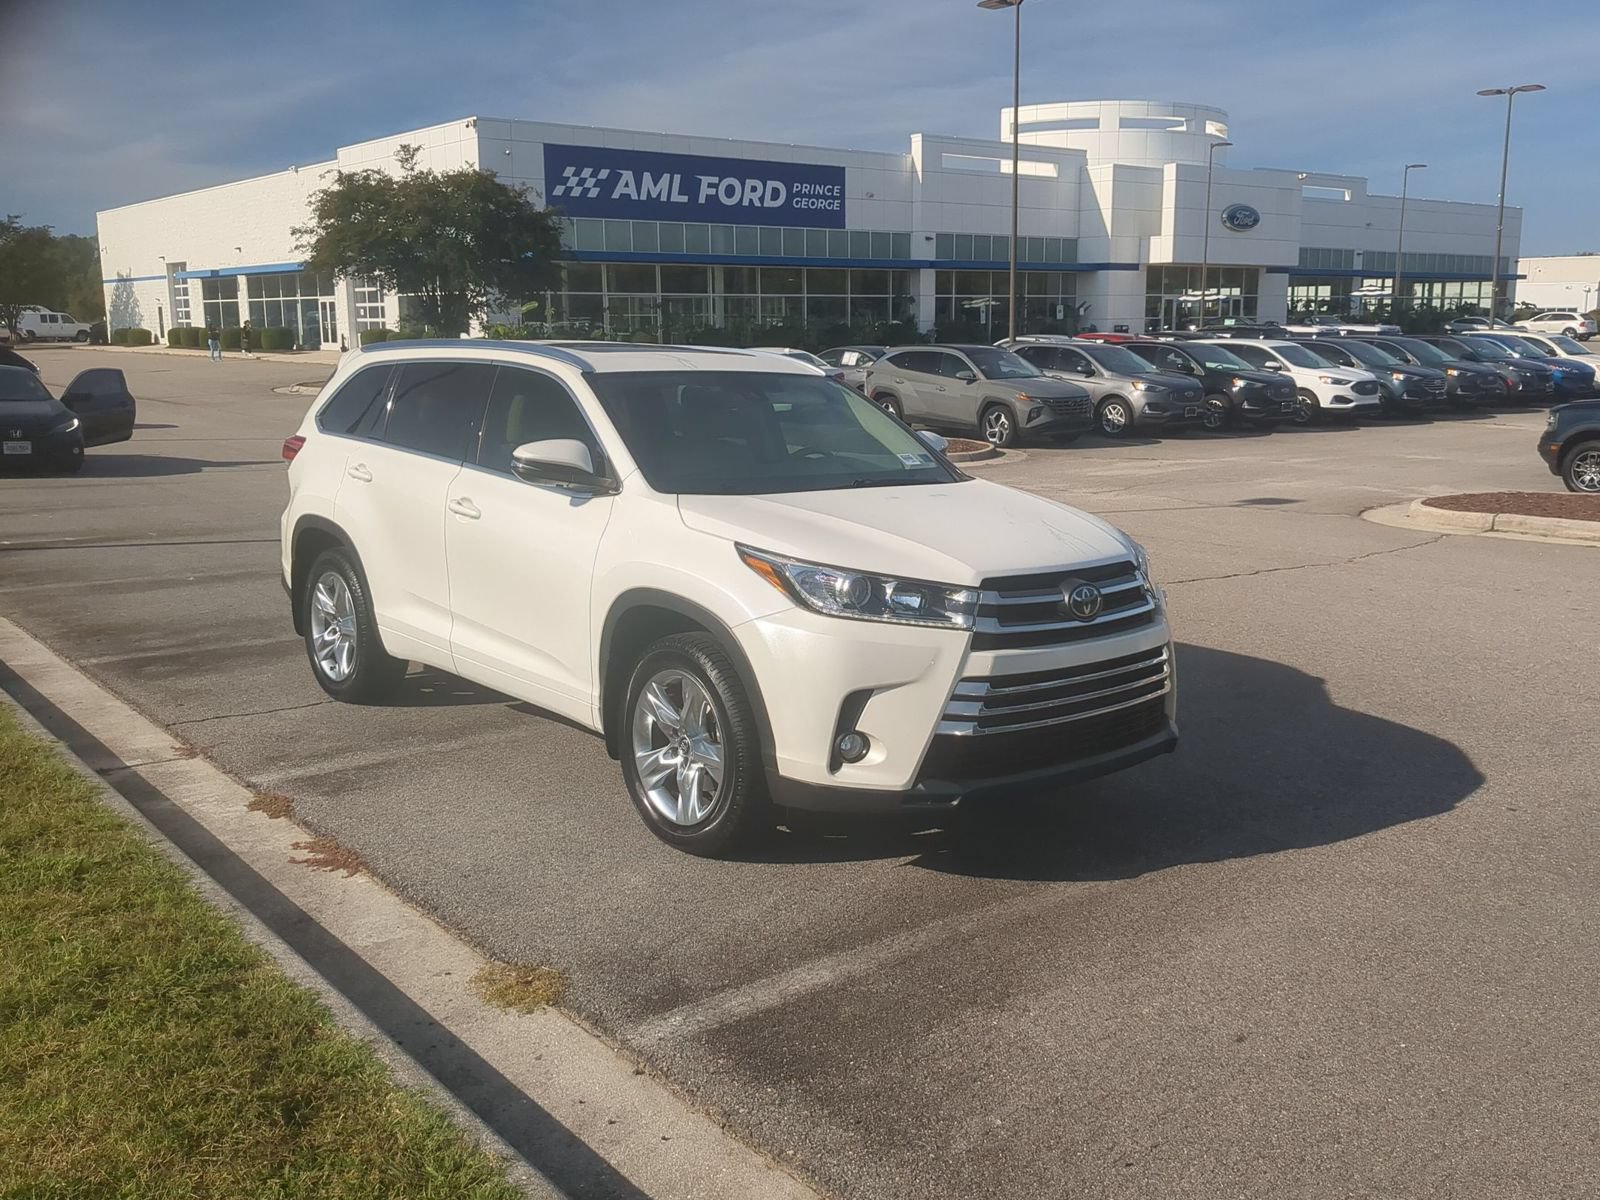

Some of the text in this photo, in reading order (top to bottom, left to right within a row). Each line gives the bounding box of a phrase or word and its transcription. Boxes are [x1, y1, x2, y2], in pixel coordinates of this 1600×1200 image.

[611, 169, 787, 208] AML FORD
[792, 183, 841, 197] PRINCE
[792, 198, 841, 211] GEORGE
